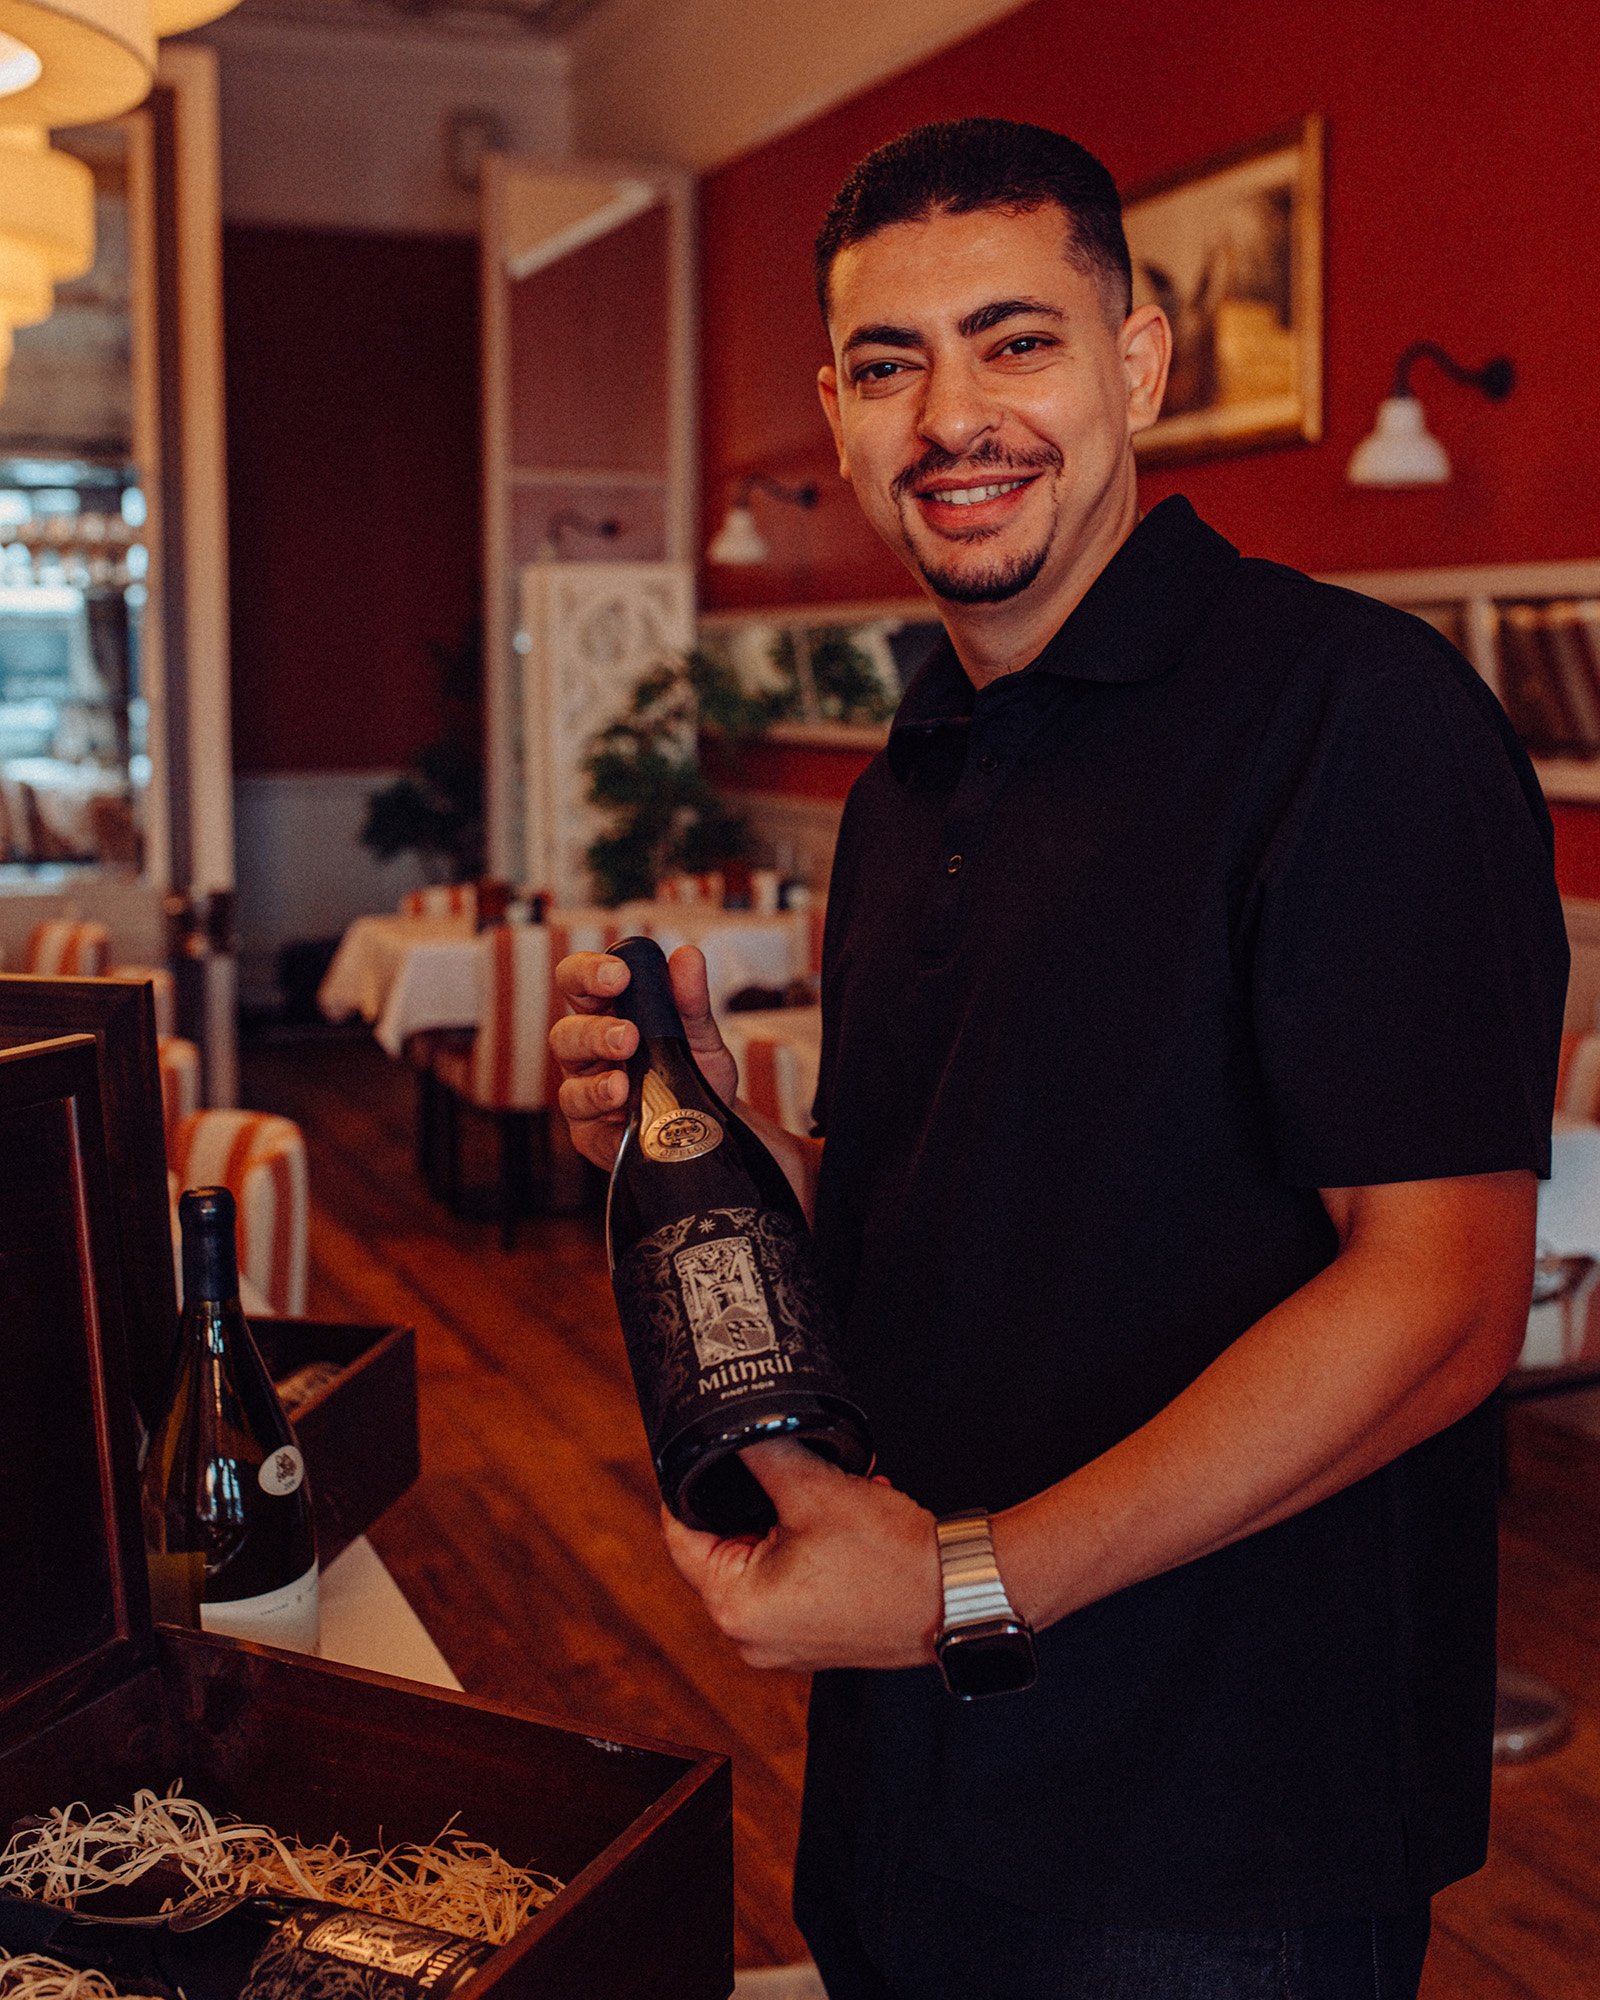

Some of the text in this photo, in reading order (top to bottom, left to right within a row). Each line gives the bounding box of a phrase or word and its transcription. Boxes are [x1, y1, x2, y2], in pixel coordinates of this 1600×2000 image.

[654, 1110, 707, 1130] LOTHIAN
[660, 1138, 713, 1158] OF ELGIN
[720, 1379, 776, 1401] PINOT NOIR
